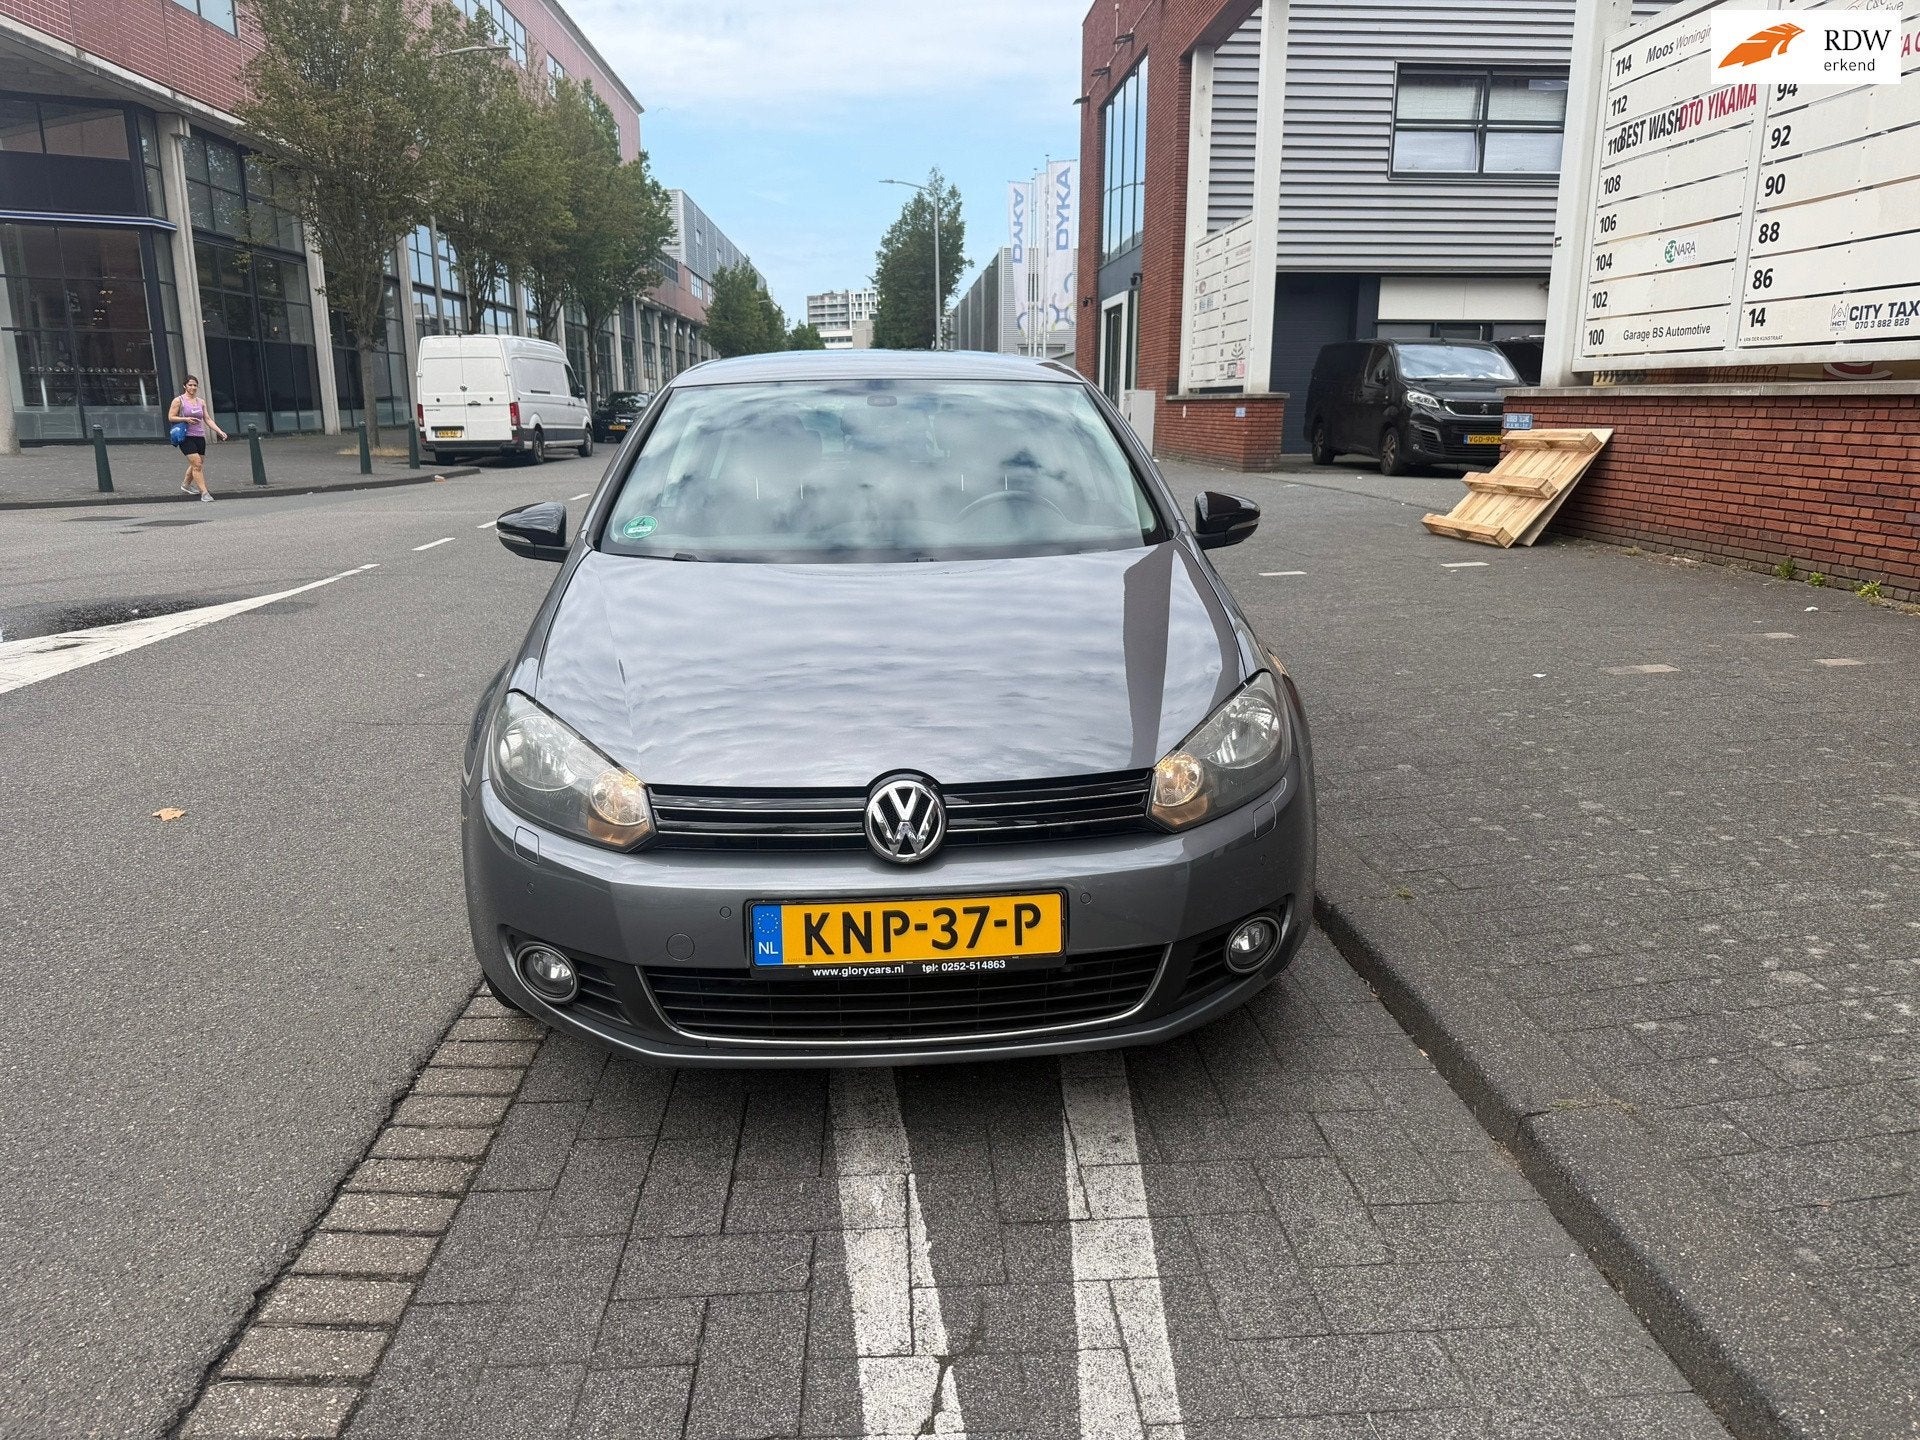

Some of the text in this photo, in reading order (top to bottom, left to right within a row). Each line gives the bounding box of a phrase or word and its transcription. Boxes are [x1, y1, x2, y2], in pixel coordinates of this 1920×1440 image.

[1646, 42, 1675, 64] Moos
[1616, 54, 1632, 76] 114
[1777, 84, 1798, 101] 94
[1611, 94, 1628, 116] 112
[1620, 119, 1646, 151] BEST
[1649, 107, 1681, 141] WASH
[1680, 98, 1703, 131] OTO
[1707, 84, 1757, 121] YIKAMA
[1771, 125, 1792, 149] 92
[1603, 174, 1621, 195] 108
[1765, 173, 1786, 197] 90
[1056, 166, 1071, 250] DYKA
[1599, 213, 1617, 233] 106
[1758, 221, 1780, 244] 88
[1595, 252, 1613, 272] 104
[1752, 267, 1774, 290] 86
[1592, 290, 1608, 309] 102
[1748, 307, 1766, 327] 14
[1849, 303, 1883, 322] CITY
[1855, 321, 1869, 329] 070
[1870, 320, 1875, 328] 3
[1894, 317, 1910, 326] 828
[1588, 323, 1711, 346] 100 Garage BS Automotive
[758, 902, 1042, 956] NL KNP-37-P
[812, 964, 905, 977] www.glorycars.nl
[941, 960, 1006, 973] 0252-514863
